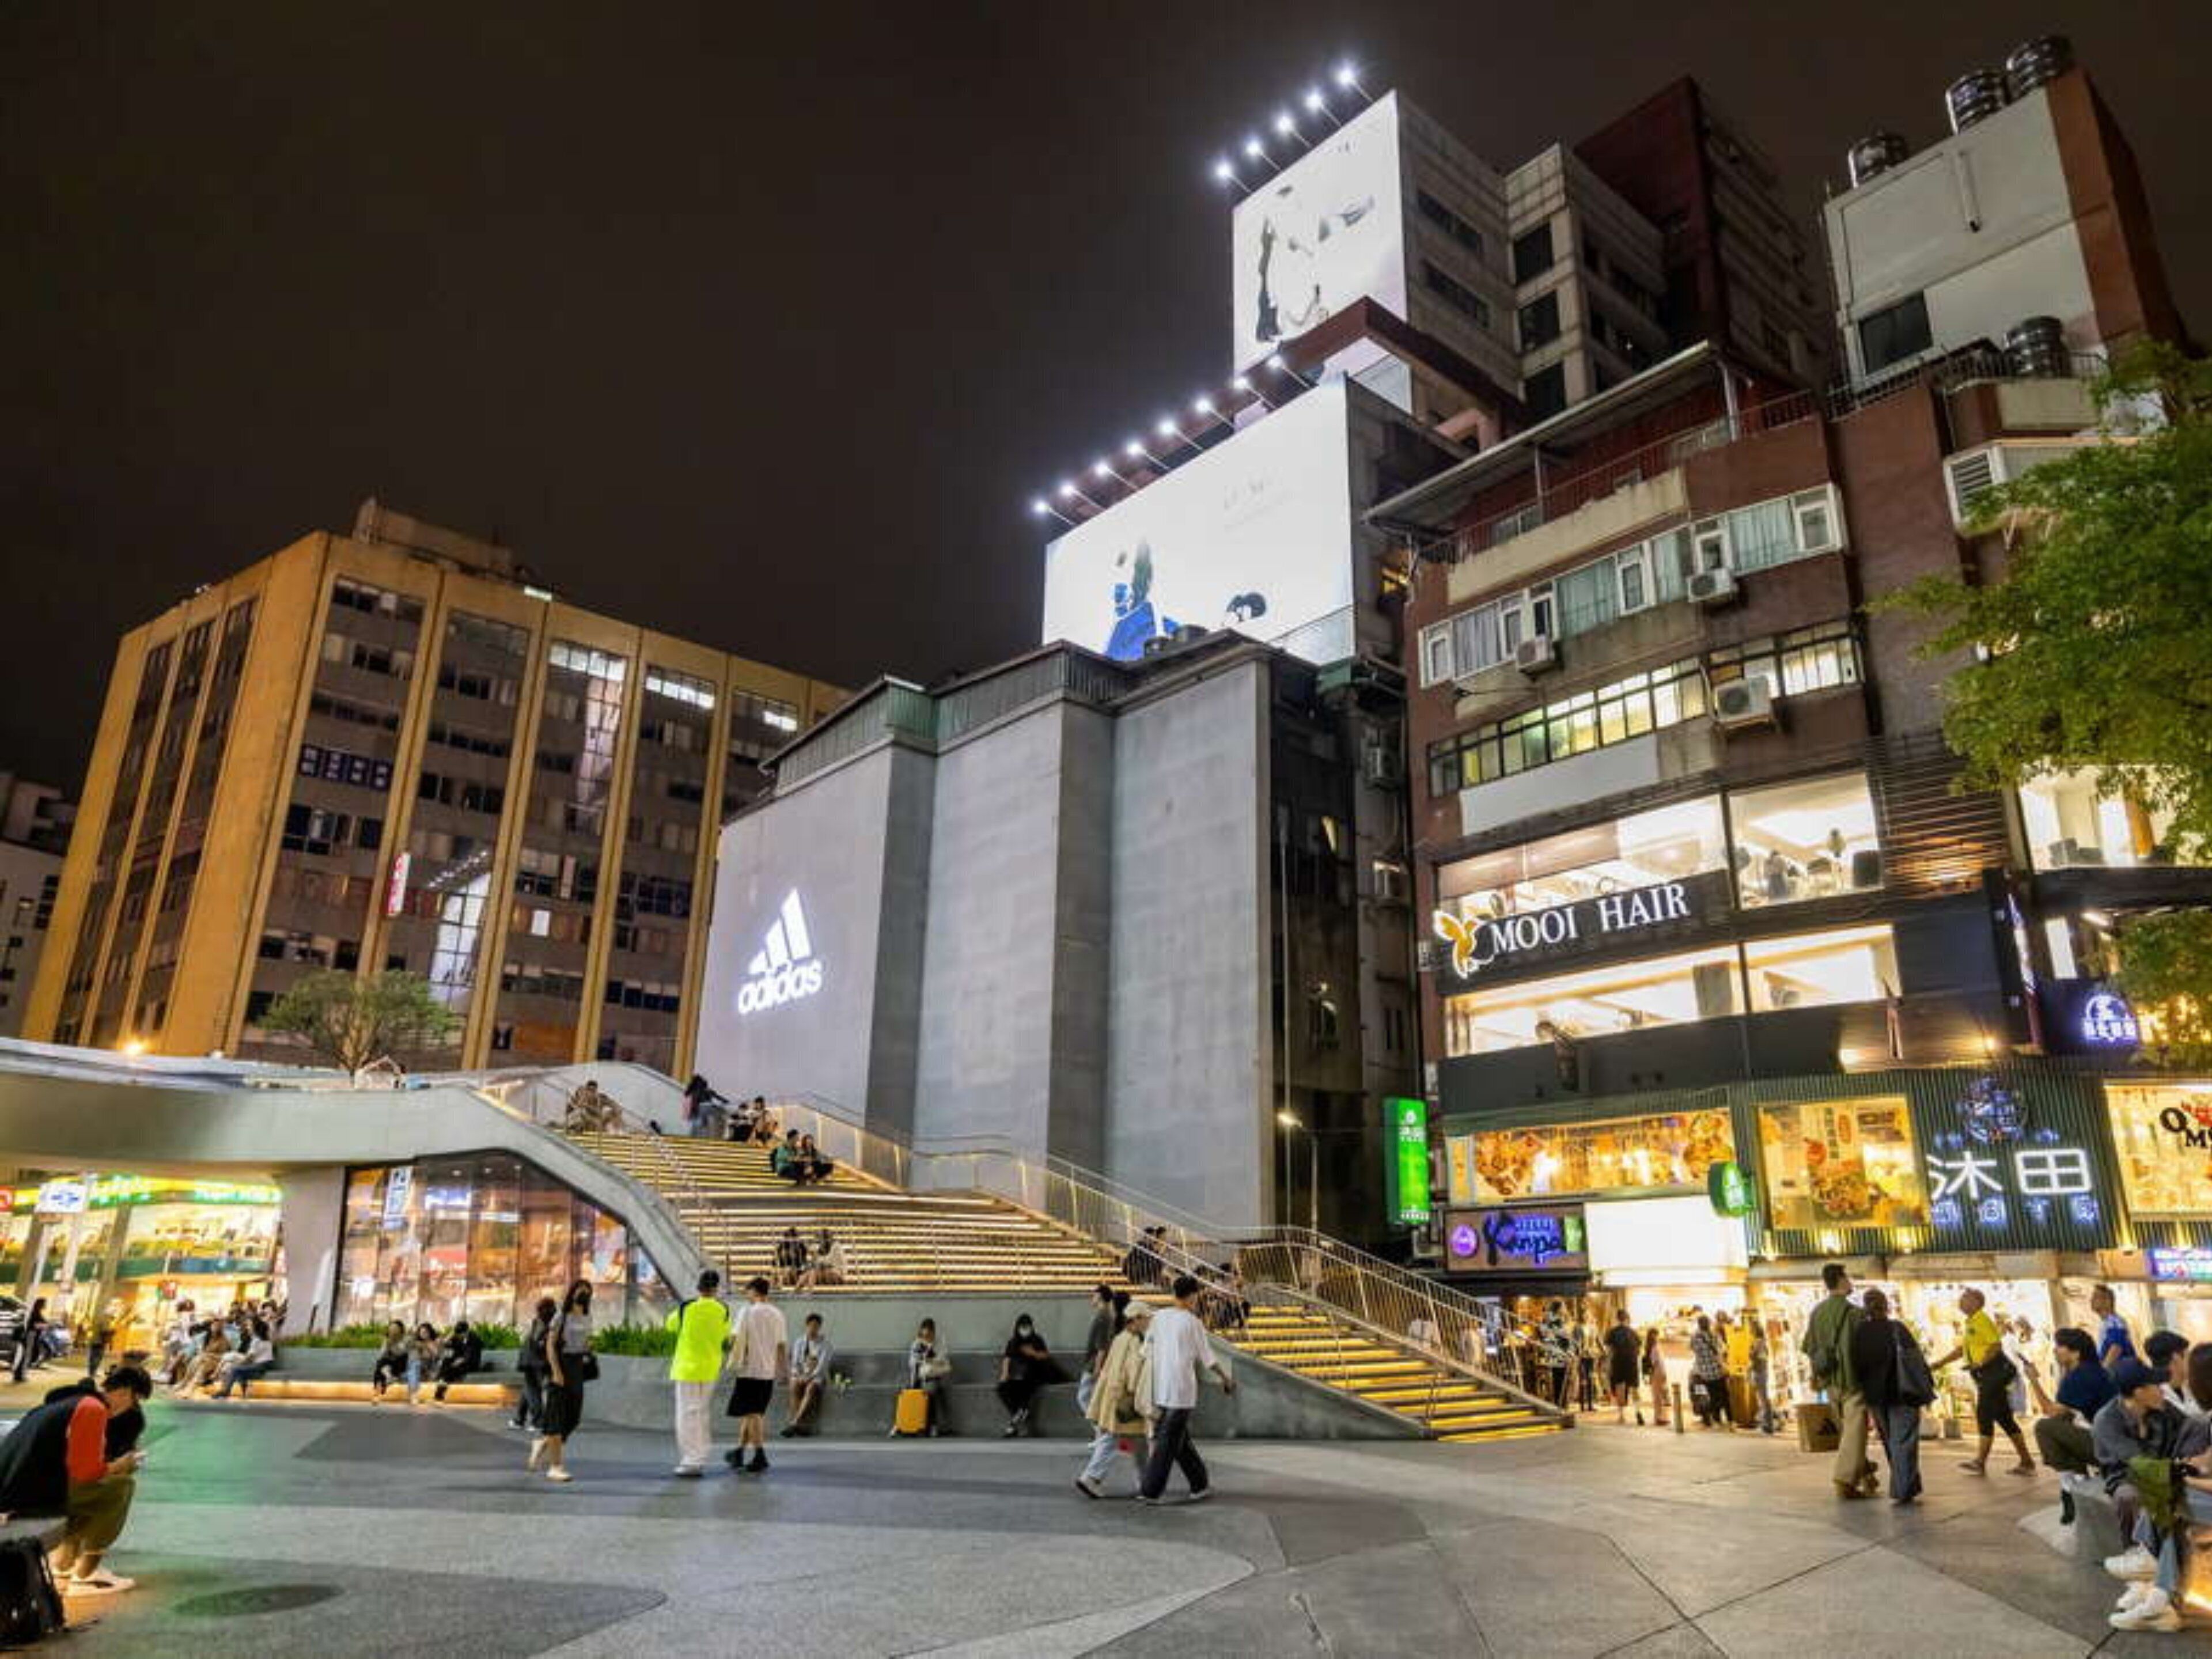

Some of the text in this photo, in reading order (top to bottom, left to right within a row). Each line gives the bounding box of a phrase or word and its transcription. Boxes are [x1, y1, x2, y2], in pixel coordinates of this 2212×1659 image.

[1491, 883, 1691, 954] MOOI HAIR
[738, 959, 822, 1014] adidas
[1925, 1149, 2092, 1200] 沐田
